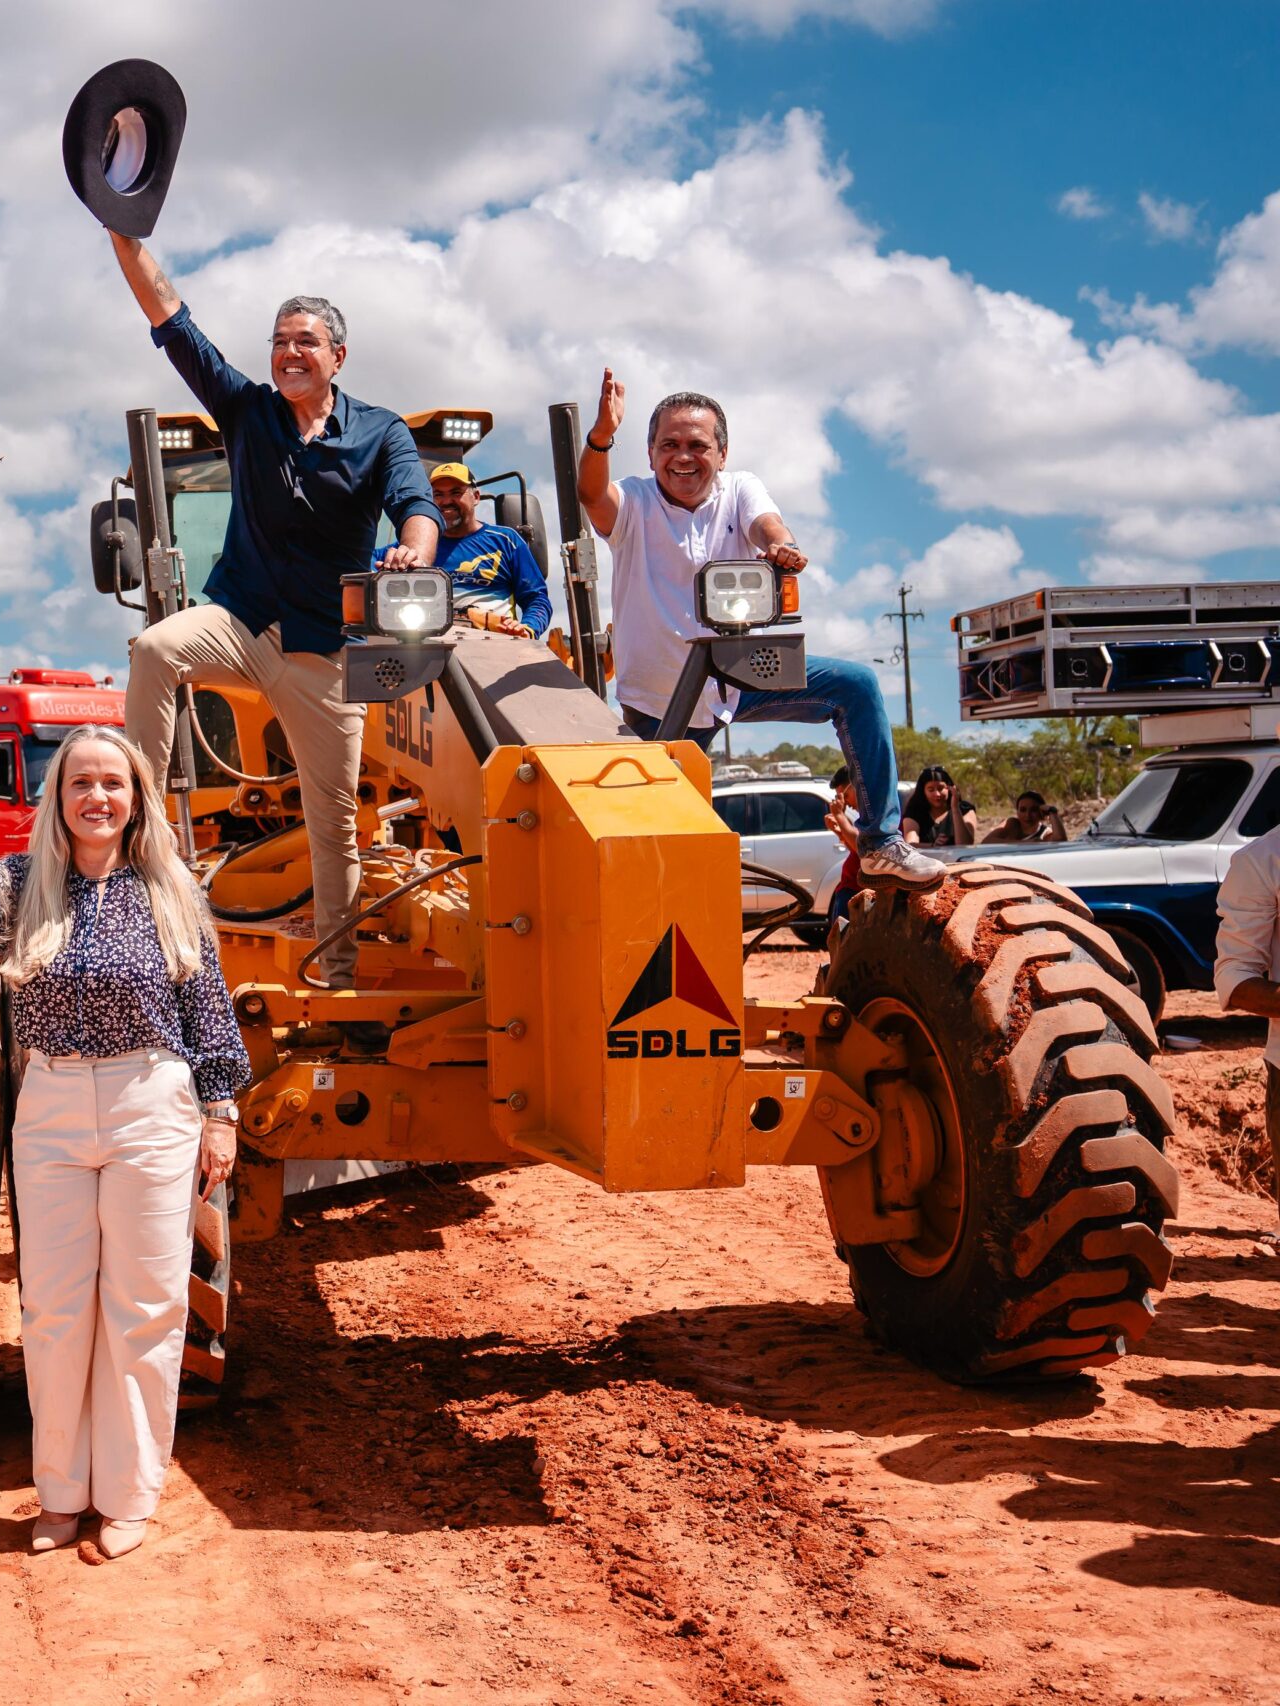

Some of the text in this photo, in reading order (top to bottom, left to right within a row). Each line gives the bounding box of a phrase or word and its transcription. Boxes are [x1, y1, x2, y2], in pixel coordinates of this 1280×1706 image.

[39, 700, 125, 718] Mercedes-B
[385, 698, 433, 768] SDLG
[607, 1029, 741, 1058] SDLG
